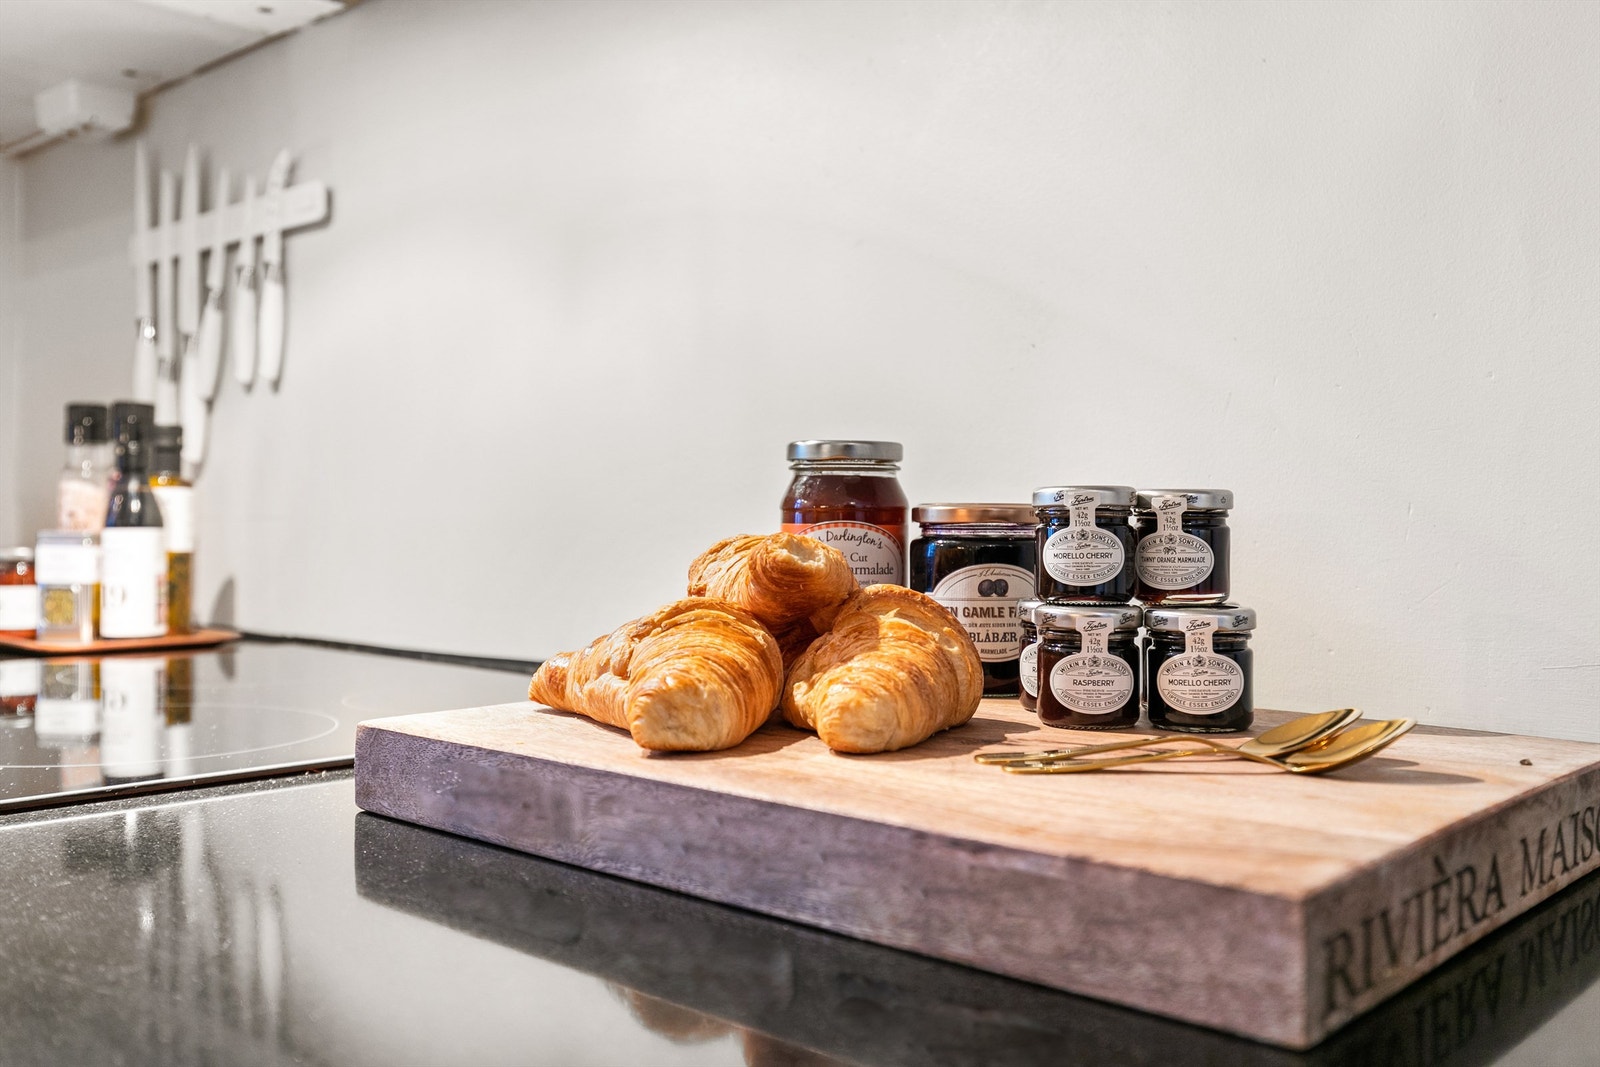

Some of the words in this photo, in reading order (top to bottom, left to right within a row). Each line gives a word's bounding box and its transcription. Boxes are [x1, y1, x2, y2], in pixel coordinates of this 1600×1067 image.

[1077, 512, 1089, 520] 42g
[1165, 516, 1176, 525] 42g
[826, 528, 884, 549] Darlington's
[1051, 535, 1068, 548] WILKIN
[1091, 533, 1107, 543] SONS
[1106, 539, 1116, 548] LTD
[1178, 537, 1195, 546] SONS
[850, 552, 868, 562] Cut
[1053, 552, 1085, 560] MORELLO
[1156, 556, 1177, 564] ORANGE
[1177, 556, 1206, 564] MARMALADE
[850, 562, 894, 575] armalade
[1093, 565, 1116, 579] ENGLAND
[1180, 568, 1205, 582] ENGLAND
[962, 606, 1005, 619] GAMLE
[969, 629, 1018, 643] BLÅBÆR
[1089, 637, 1101, 646] 42g
[1192, 637, 1205, 646] 42g
[1060, 661, 1080, 673] WILKIN
[1103, 660, 1118, 669] SONS
[1117, 665, 1127, 675] LTD
[1166, 660, 1184, 674] WILKIN
[1208, 660, 1225, 669] SONS
[1224, 665, 1235, 674] LTD
[1072, 679, 1115, 687] RASPBERRY
[1168, 679, 1202, 687] MORELLO
[1203, 679, 1232, 687] CHERRY
[1104, 691, 1127, 707] ENGLAND
[1211, 691, 1235, 707] ENGLAND
[1322, 852, 1507, 1018] RIVIÈRA
